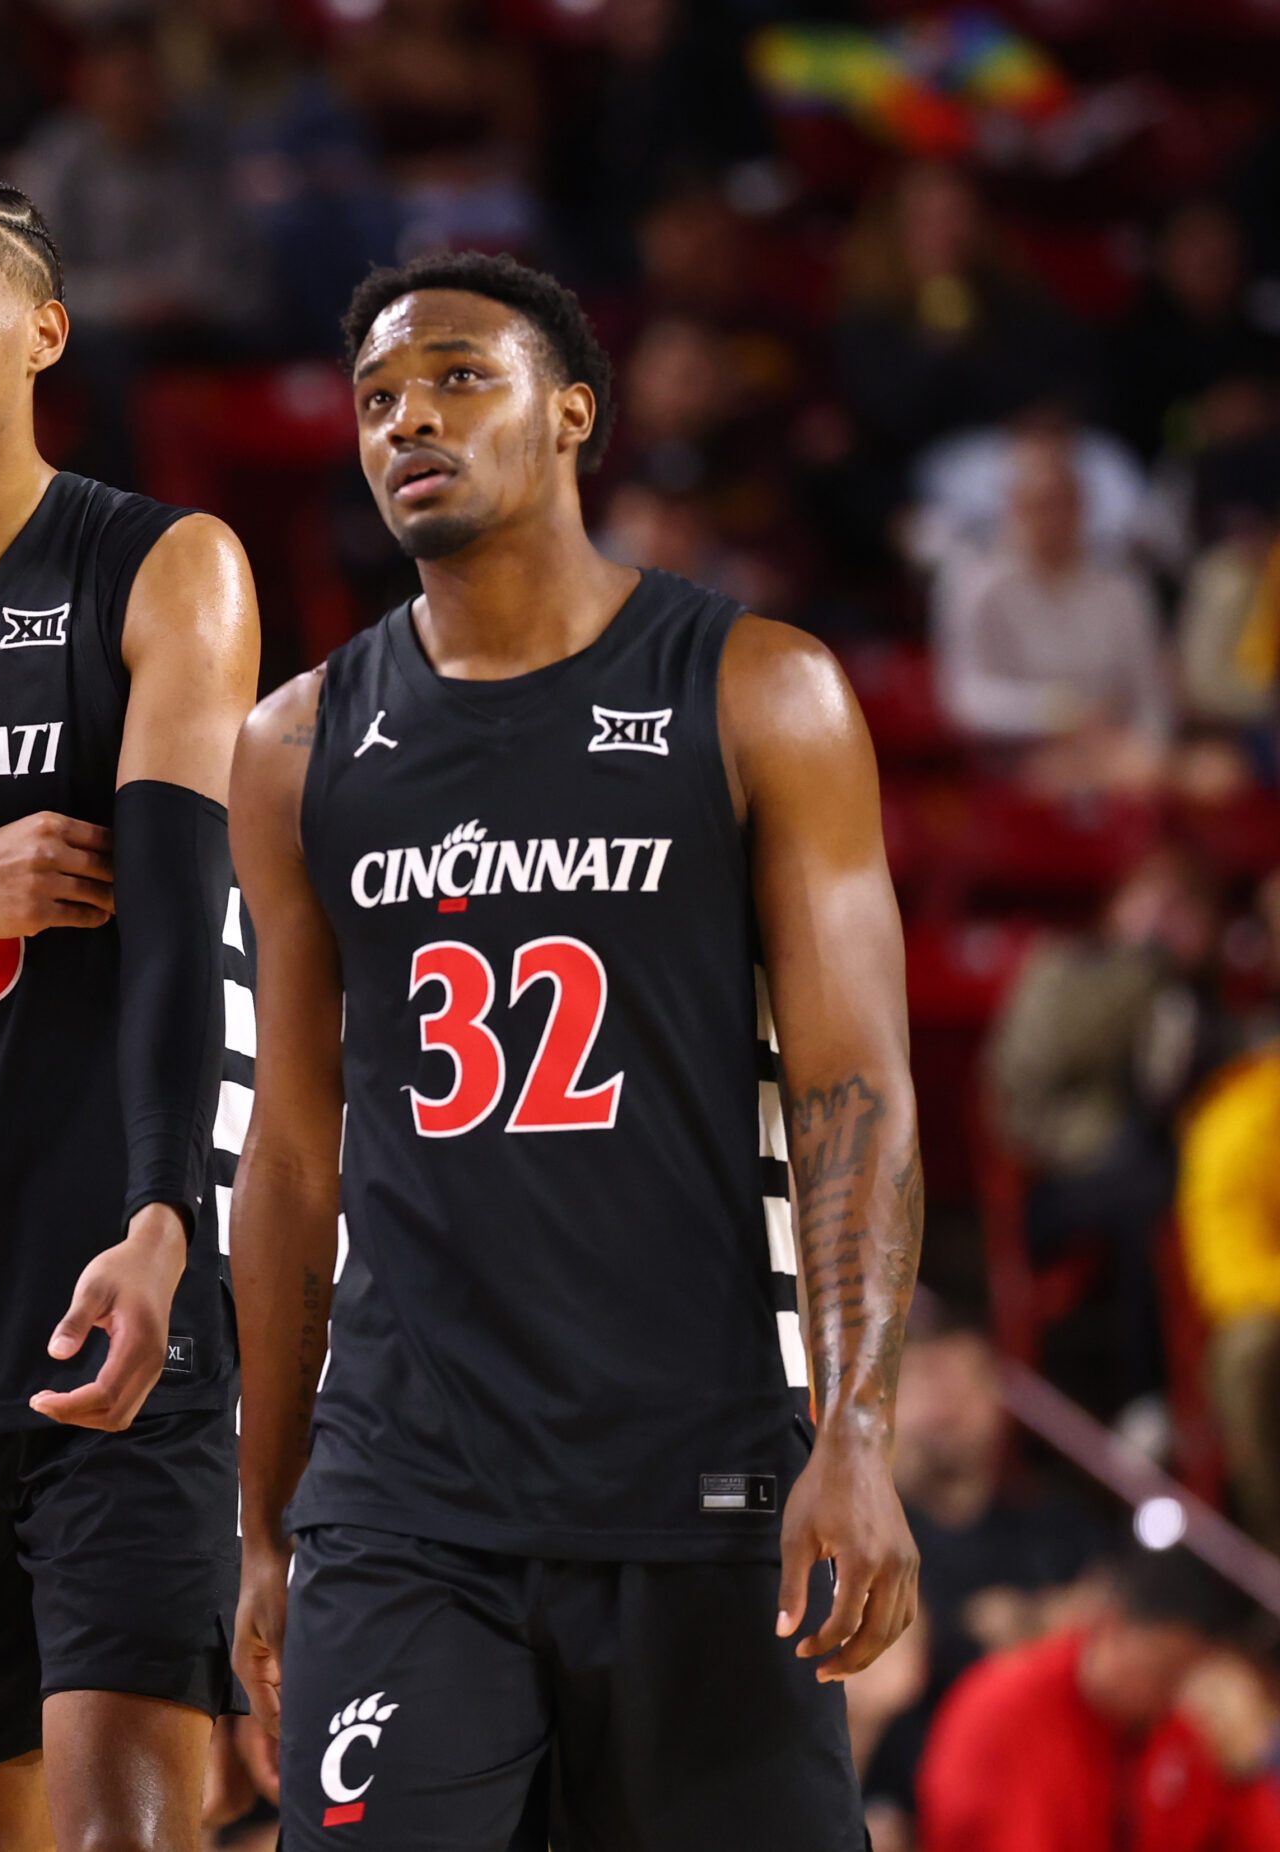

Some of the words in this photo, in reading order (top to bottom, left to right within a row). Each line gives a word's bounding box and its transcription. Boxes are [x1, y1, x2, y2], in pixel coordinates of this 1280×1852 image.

[351, 836, 673, 909] CINCINNATI
[401, 936, 625, 1139] 32
[168, 1345, 185, 1361] XL
[760, 1485, 768, 1502] L
